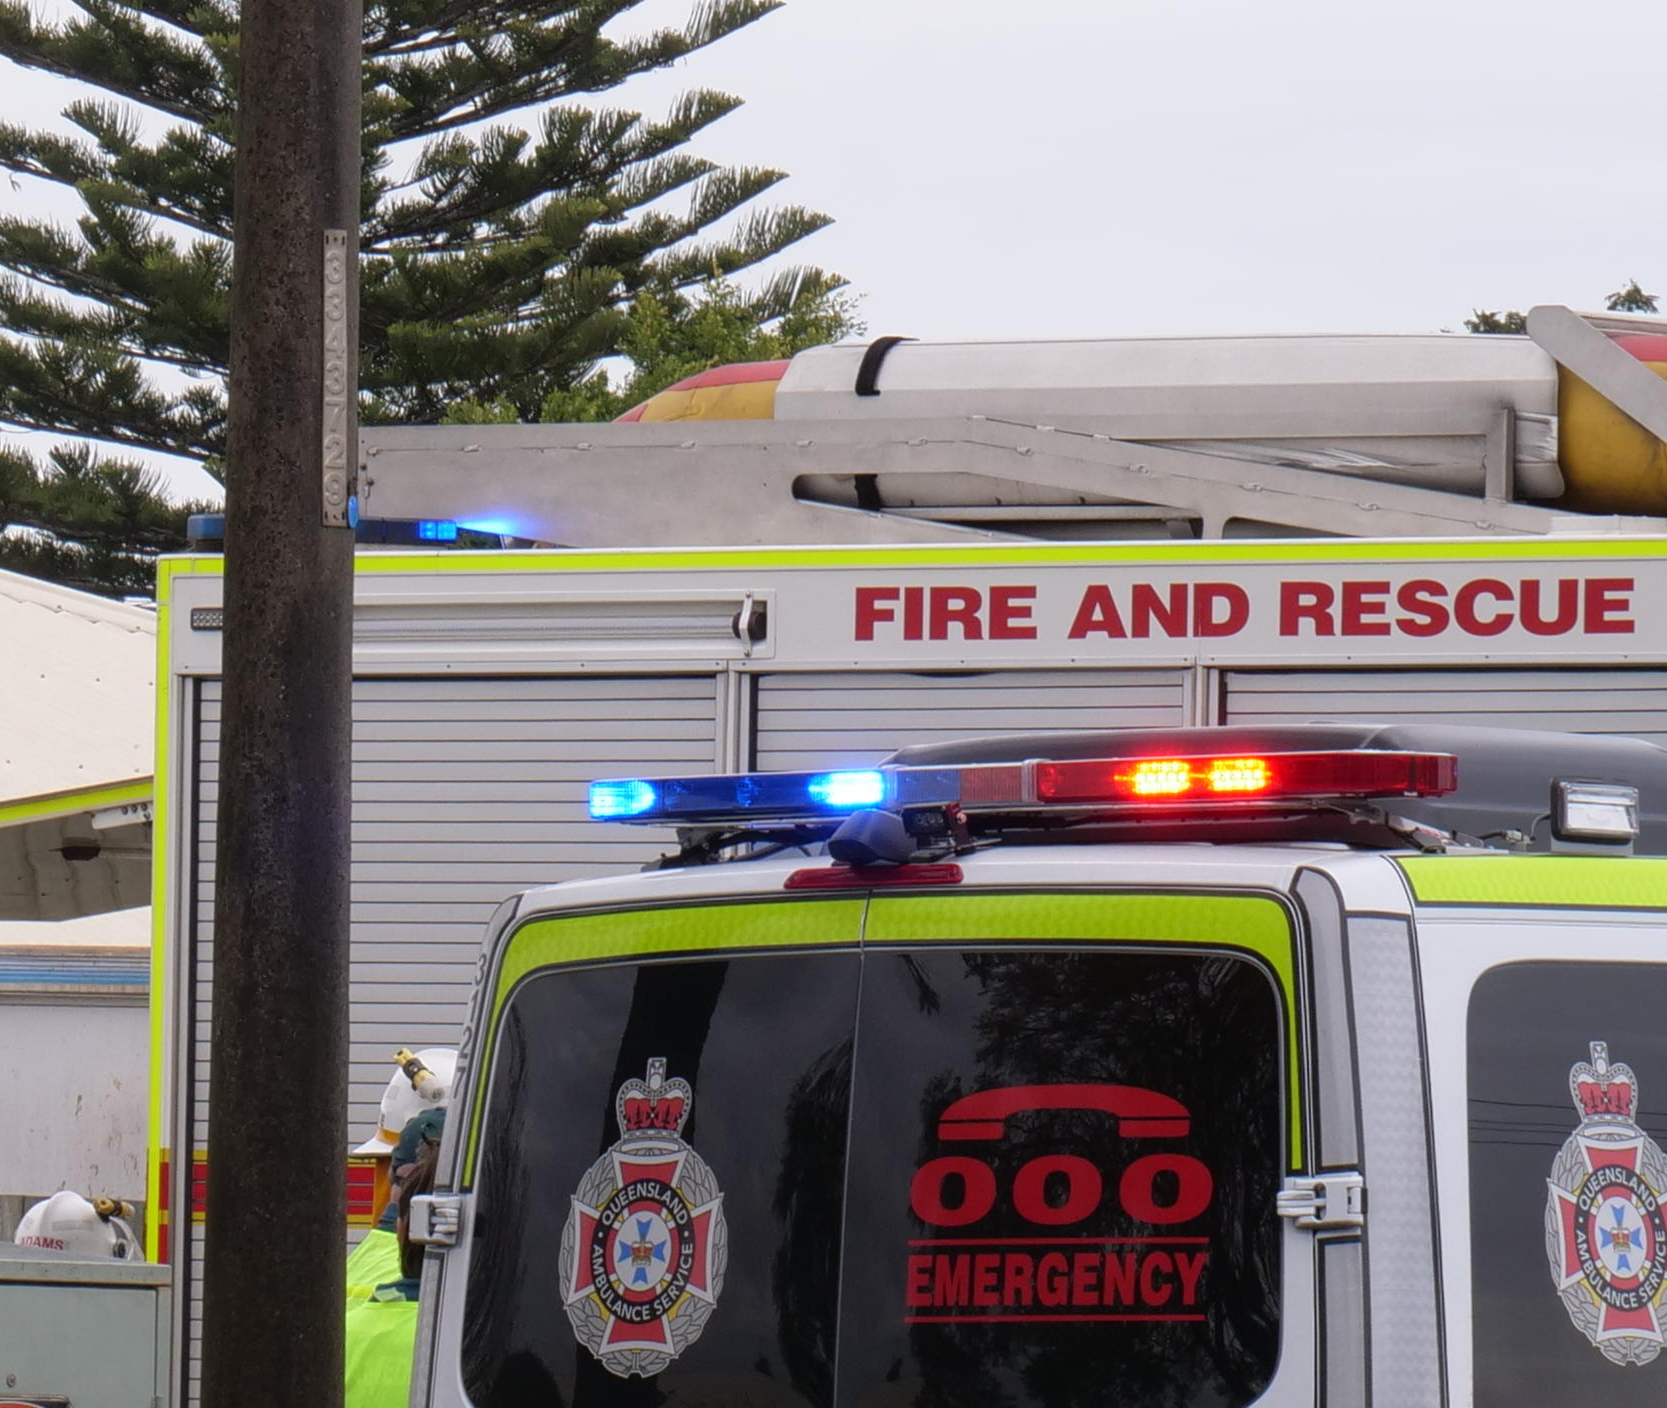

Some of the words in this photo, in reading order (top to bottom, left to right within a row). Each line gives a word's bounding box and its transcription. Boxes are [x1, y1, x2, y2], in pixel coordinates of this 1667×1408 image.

[854, 586, 1038, 641] FIRE
[1068, 583, 1250, 639] AND
[1279, 578, 1636, 637] RESCUE
[602, 1182, 688, 1226] QUEENSLAND
[910, 1153, 1214, 1227] 000
[1579, 1168, 1656, 1211] QUEENSLAND
[592, 1244, 652, 1321] AMBULANCE
[655, 1243, 693, 1319] SERVICE
[906, 1252, 1208, 1307] EMERGENCY
[1575, 1230, 1639, 1308] AMBULANCE
[1639, 1230, 1666, 1302] SERVICE
